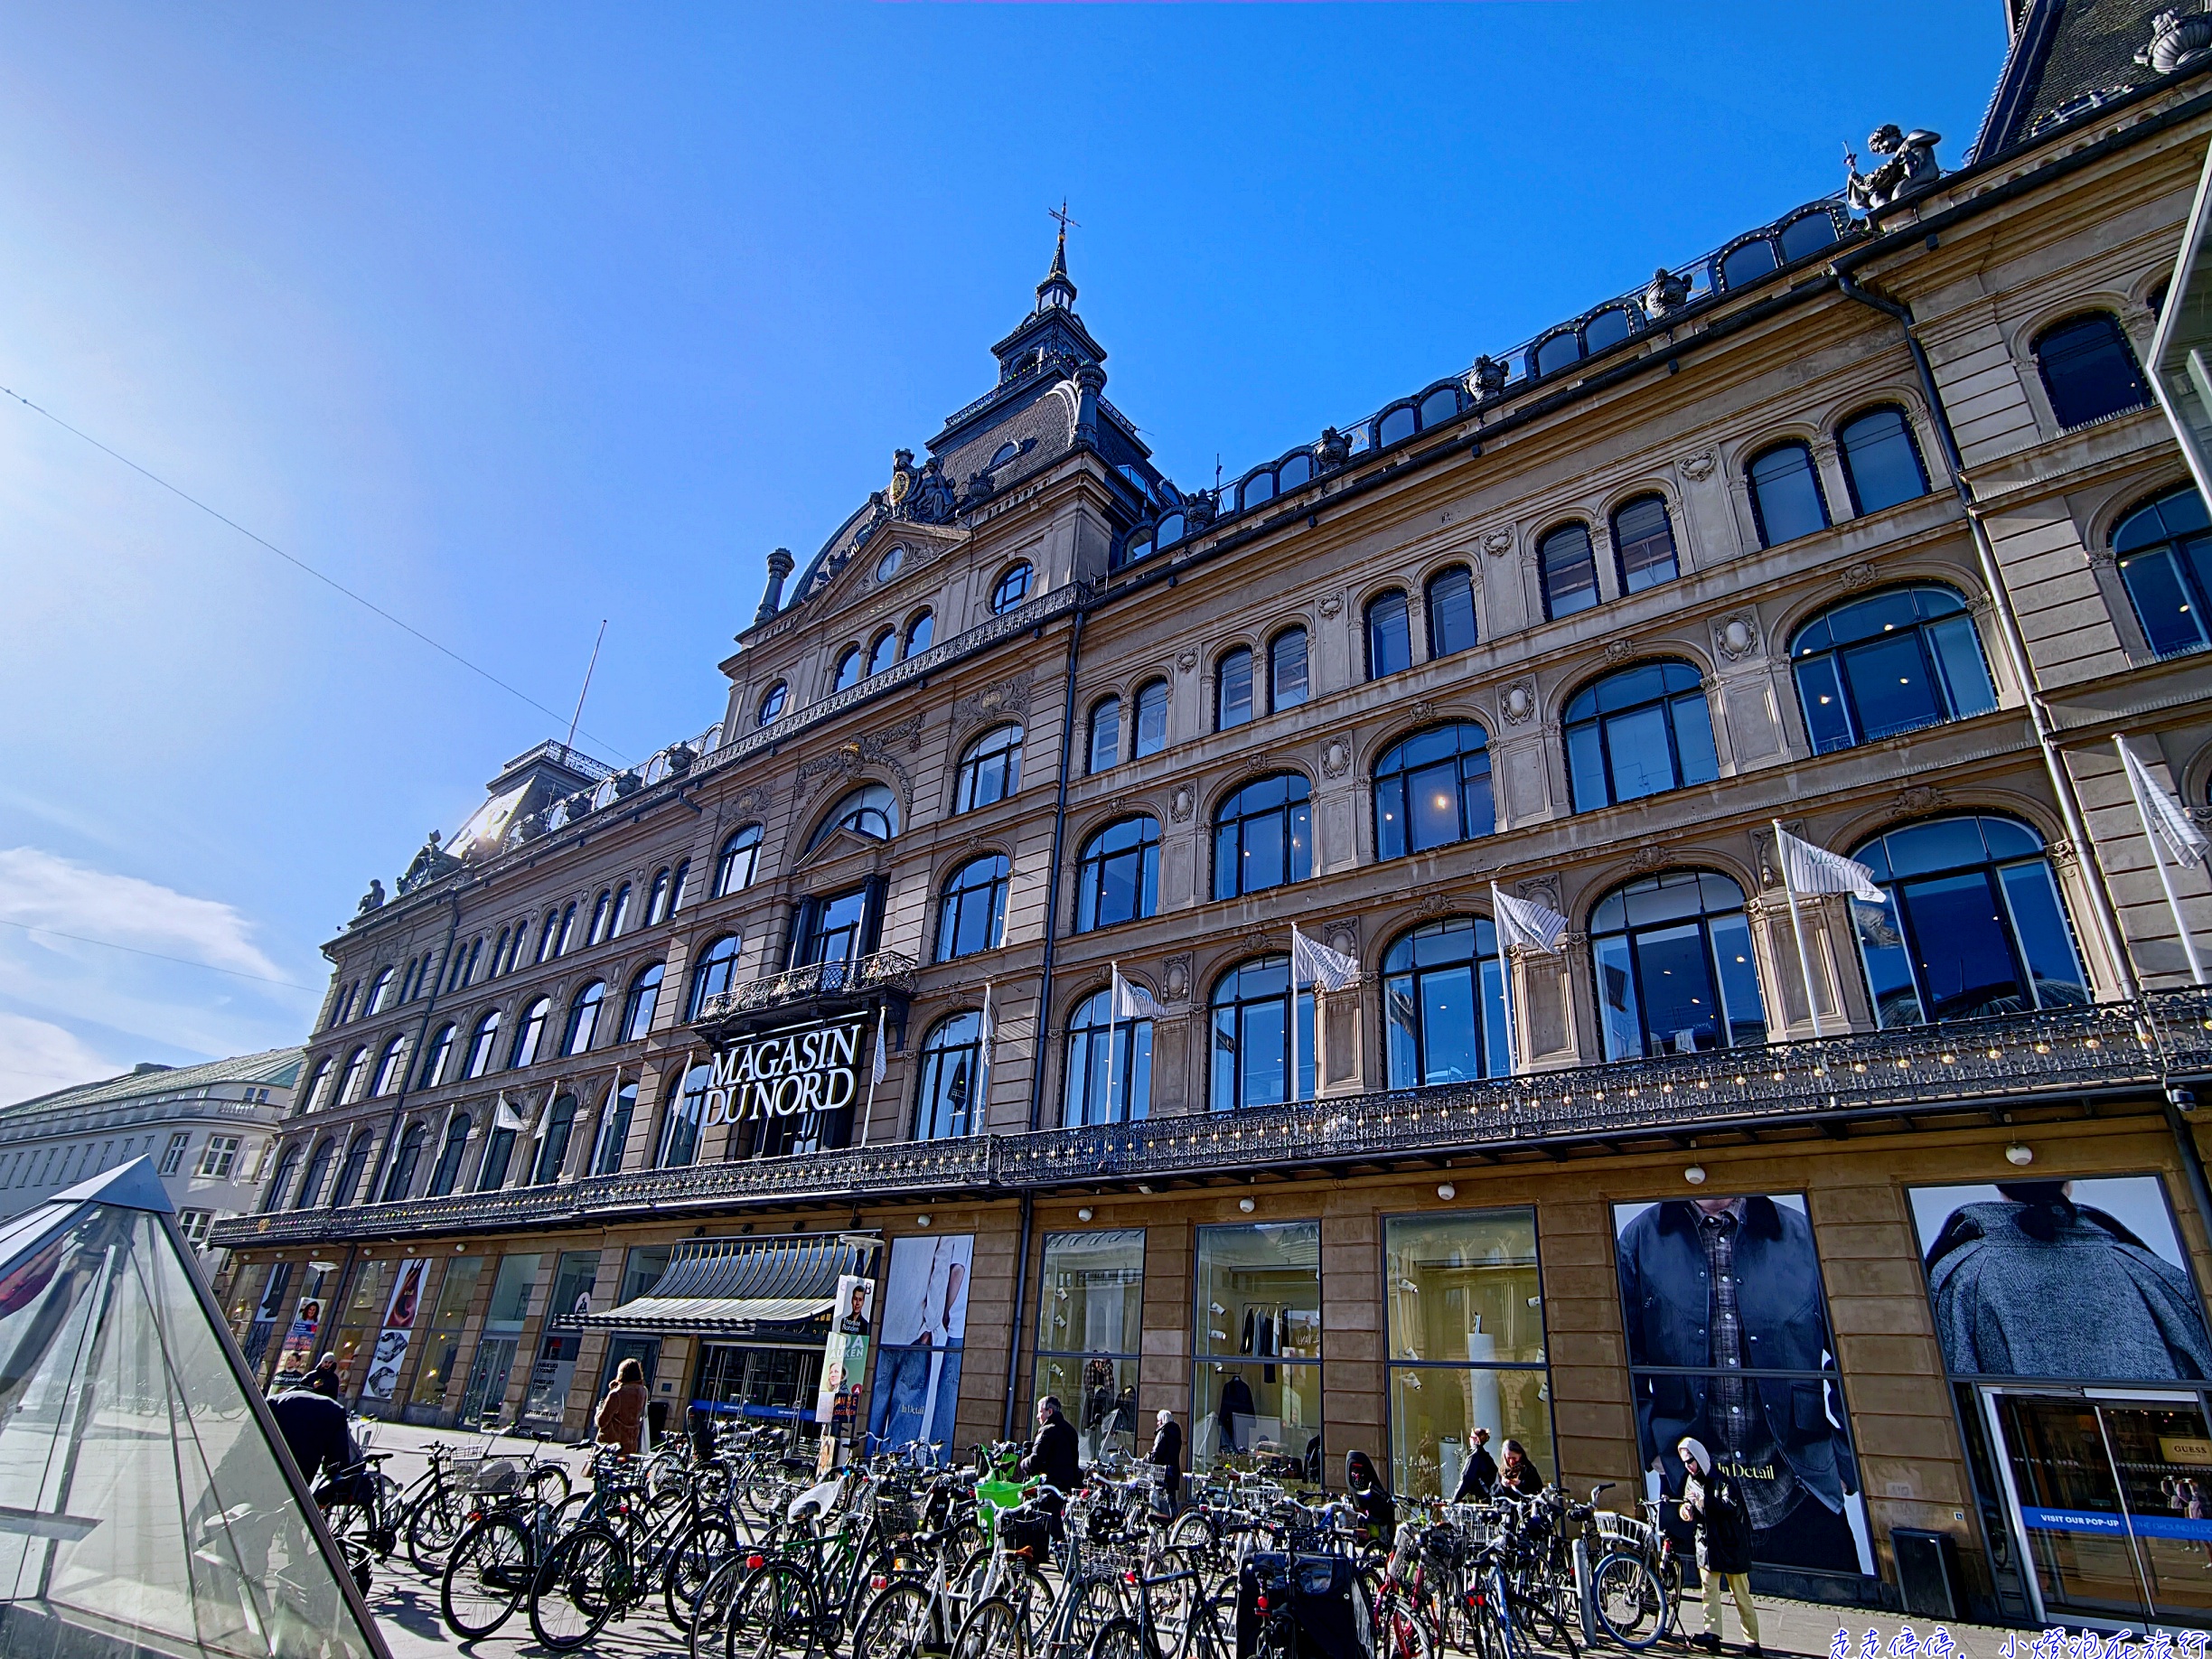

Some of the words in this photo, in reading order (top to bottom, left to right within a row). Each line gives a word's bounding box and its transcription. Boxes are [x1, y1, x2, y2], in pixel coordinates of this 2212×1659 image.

[708, 1024, 862, 1088] MAGASIN
[702, 1084, 750, 1128] DU
[750, 1067, 856, 1120] NORD
[830, 1348, 864, 1359] AUKEN
[2174, 1445, 2207, 1454] GUESS
[1732, 1463, 1775, 1480] Detail
[2040, 1514, 2064, 1523] VISIT
[2065, 1516, 2085, 1524] OUR
[2085, 1518, 2120, 1527] POP-UP
